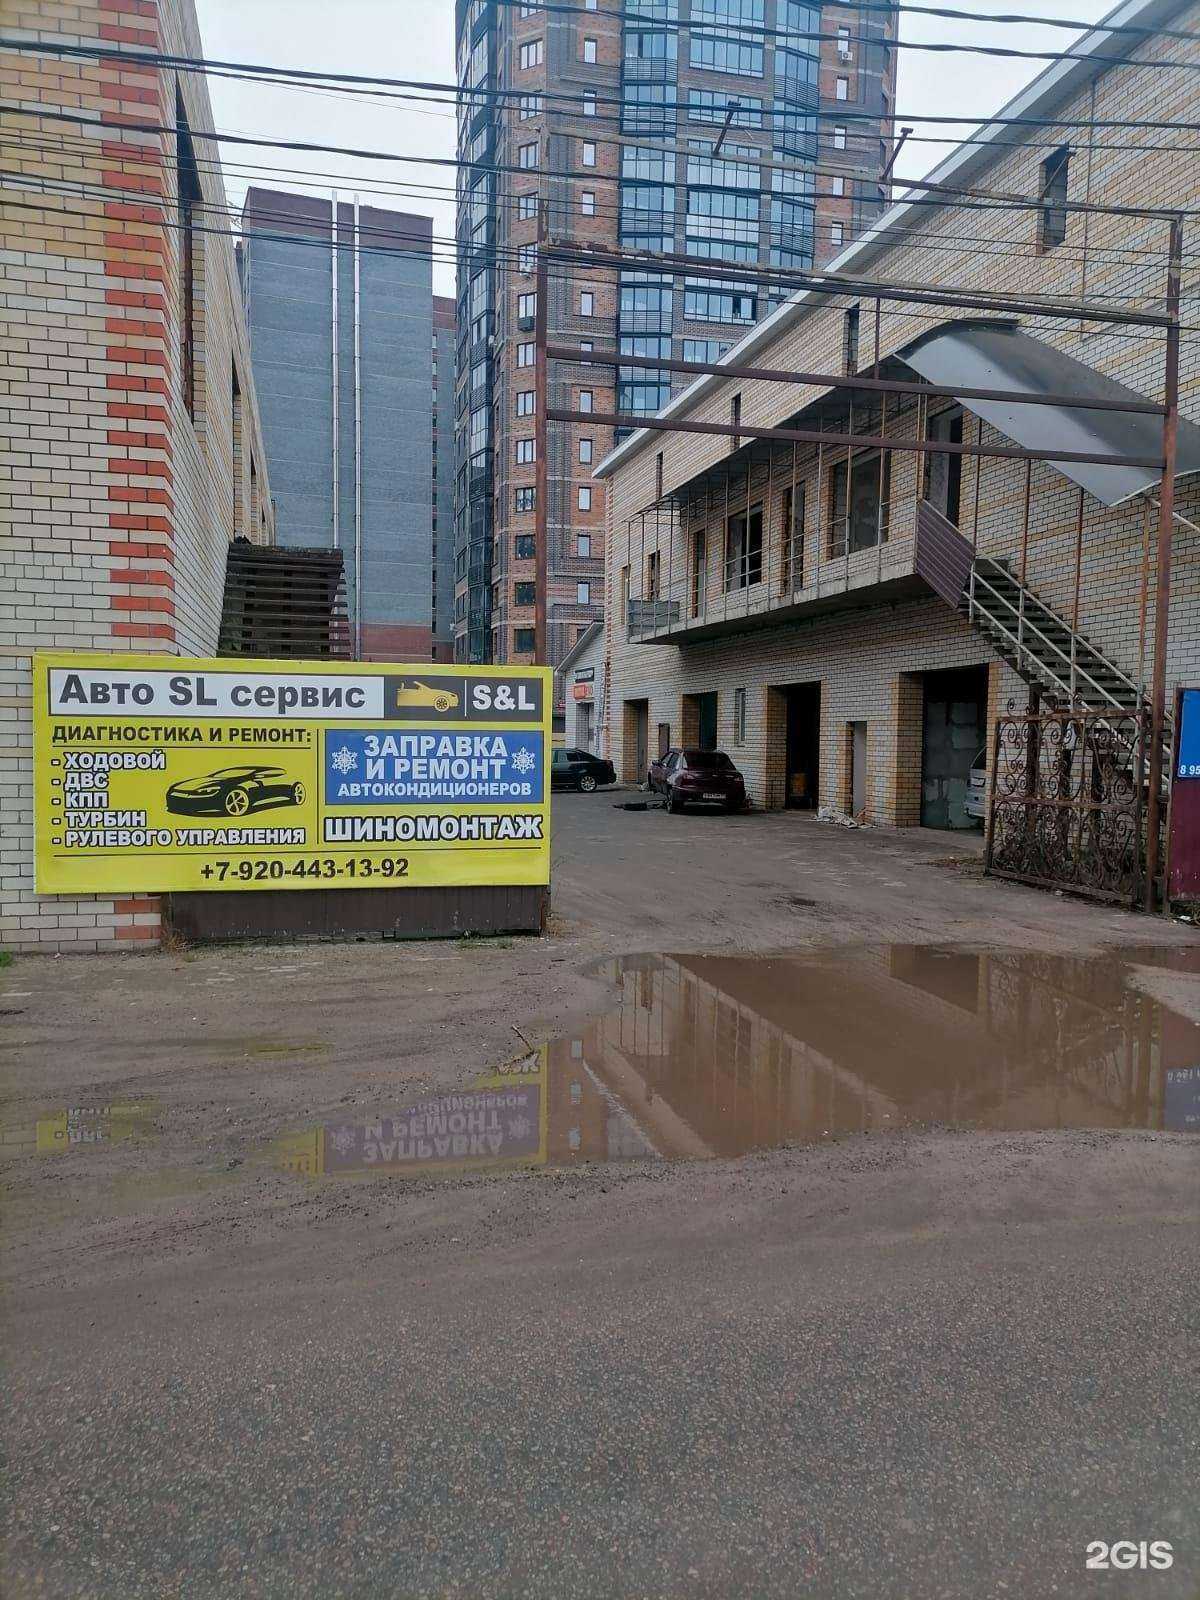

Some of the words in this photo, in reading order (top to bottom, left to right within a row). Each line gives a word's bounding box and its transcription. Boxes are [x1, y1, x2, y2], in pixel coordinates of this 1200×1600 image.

[58, 674, 155, 705] Авто
[169, 676, 219, 707] SL
[231, 684, 366, 715] сервис
[472, 684, 536, 711] S&L
[52, 725, 203, 743] ДИАГНОСТИКА
[210, 727, 222, 742] И
[229, 727, 311, 744] РЕМОНТ:
[364, 735, 509, 757] ЗАПРАВКА
[63, 750, 166, 772] ХОДОВОЙ
[366, 757, 383, 780] И
[394, 757, 506, 780] РЕМОНТ
[1179, 765, 1187, 775] 8
[63, 772, 109, 791] ДВС
[337, 782, 533, 798] АВТОКОНДИЦИОНЕРОВ
[64, 791, 109, 808] КПП
[64, 810, 147, 828] ТУРБИН
[323, 814, 544, 842] ШИНОМОНТАЖ
[64, 829, 173, 847] РУЛЕВОГО
[176, 828, 306, 846] УПРАВЛЕНИЯ
[200, 858, 409, 882] +7-920-443-13-92
